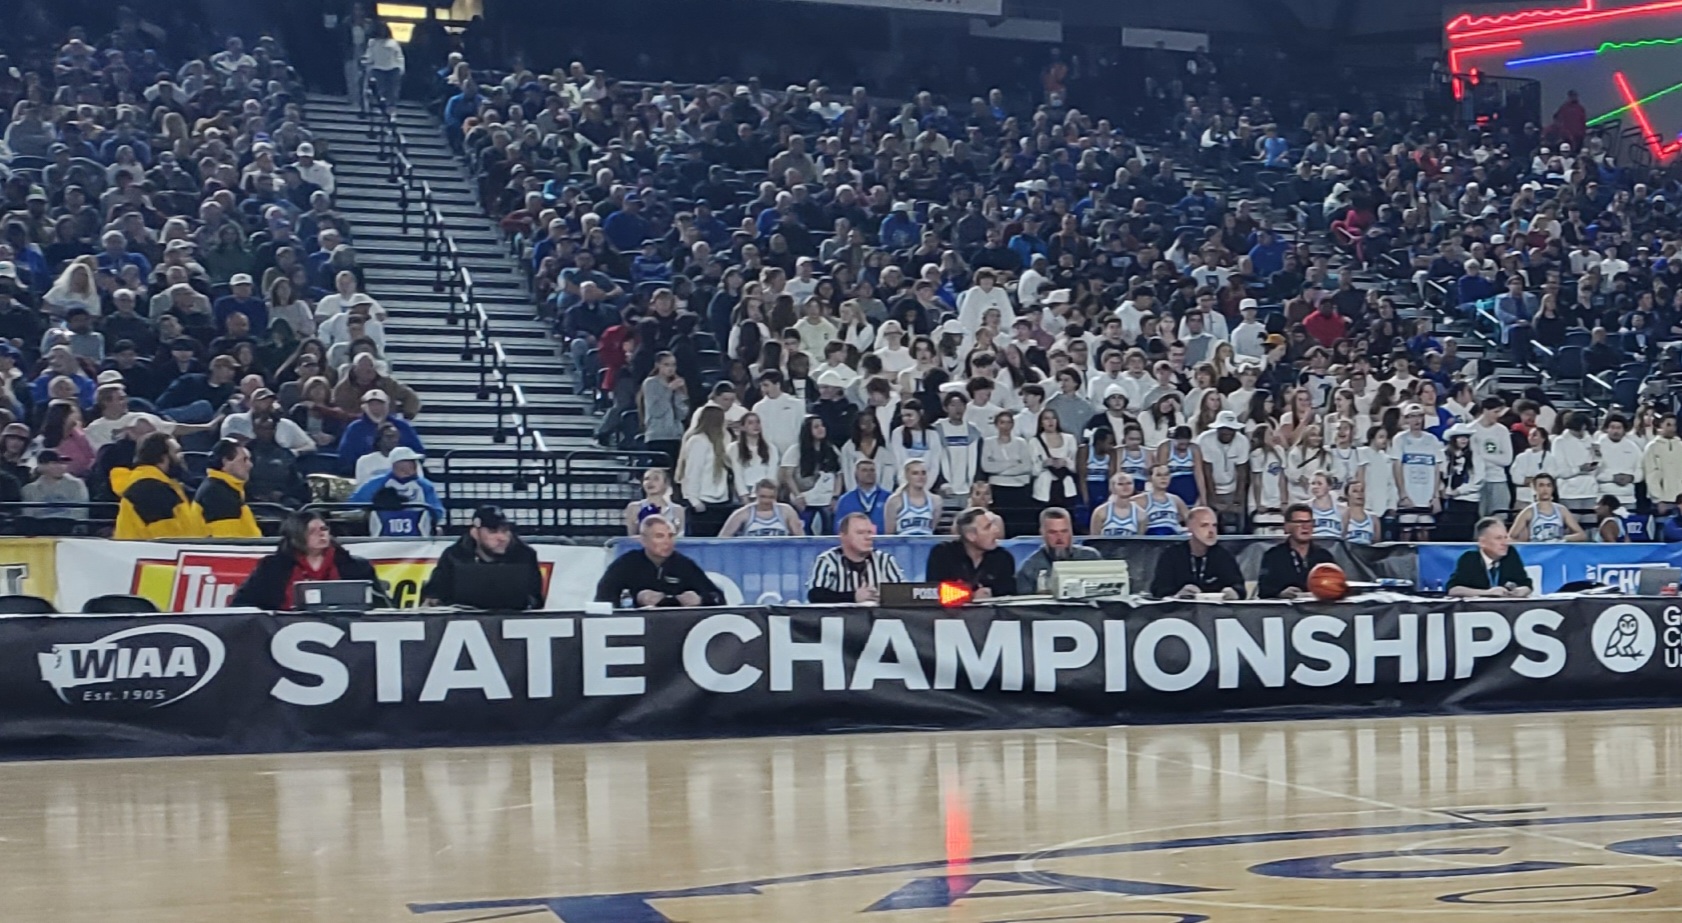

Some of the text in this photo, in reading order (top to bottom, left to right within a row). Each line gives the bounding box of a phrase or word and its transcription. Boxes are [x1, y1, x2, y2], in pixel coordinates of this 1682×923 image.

[388, 518, 412, 533] 103
[1663, 605, 1682, 626] G
[1663, 627, 1682, 647] C
[70, 646, 198, 678] WIAA
[271, 608, 1567, 706] STATE CHAMPIONSHIPS
[1664, 648, 1682, 668] U
